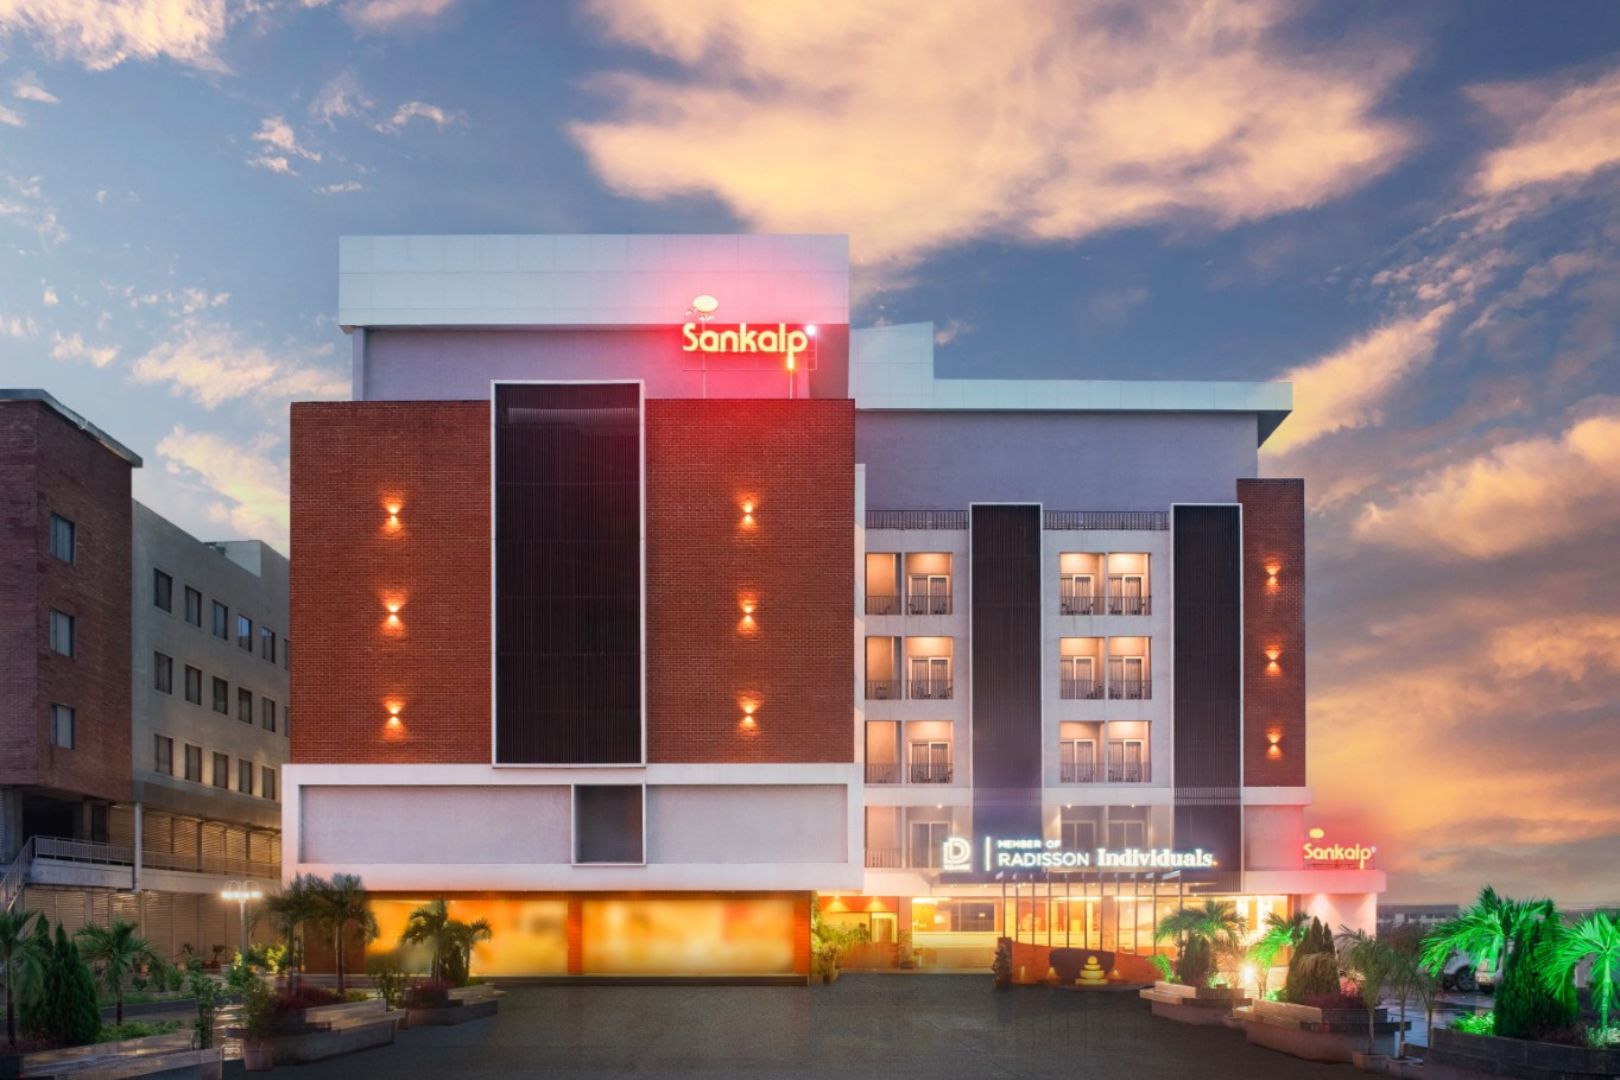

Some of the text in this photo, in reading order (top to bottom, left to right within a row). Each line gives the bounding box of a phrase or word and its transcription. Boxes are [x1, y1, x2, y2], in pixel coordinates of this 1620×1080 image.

[682, 322, 808, 370] Sankalp
[997, 839, 1062, 849] MEMBER OF
[998, 848, 1213, 867] RADISSON Individuals
[1303, 843, 1372, 870] Sankalp
